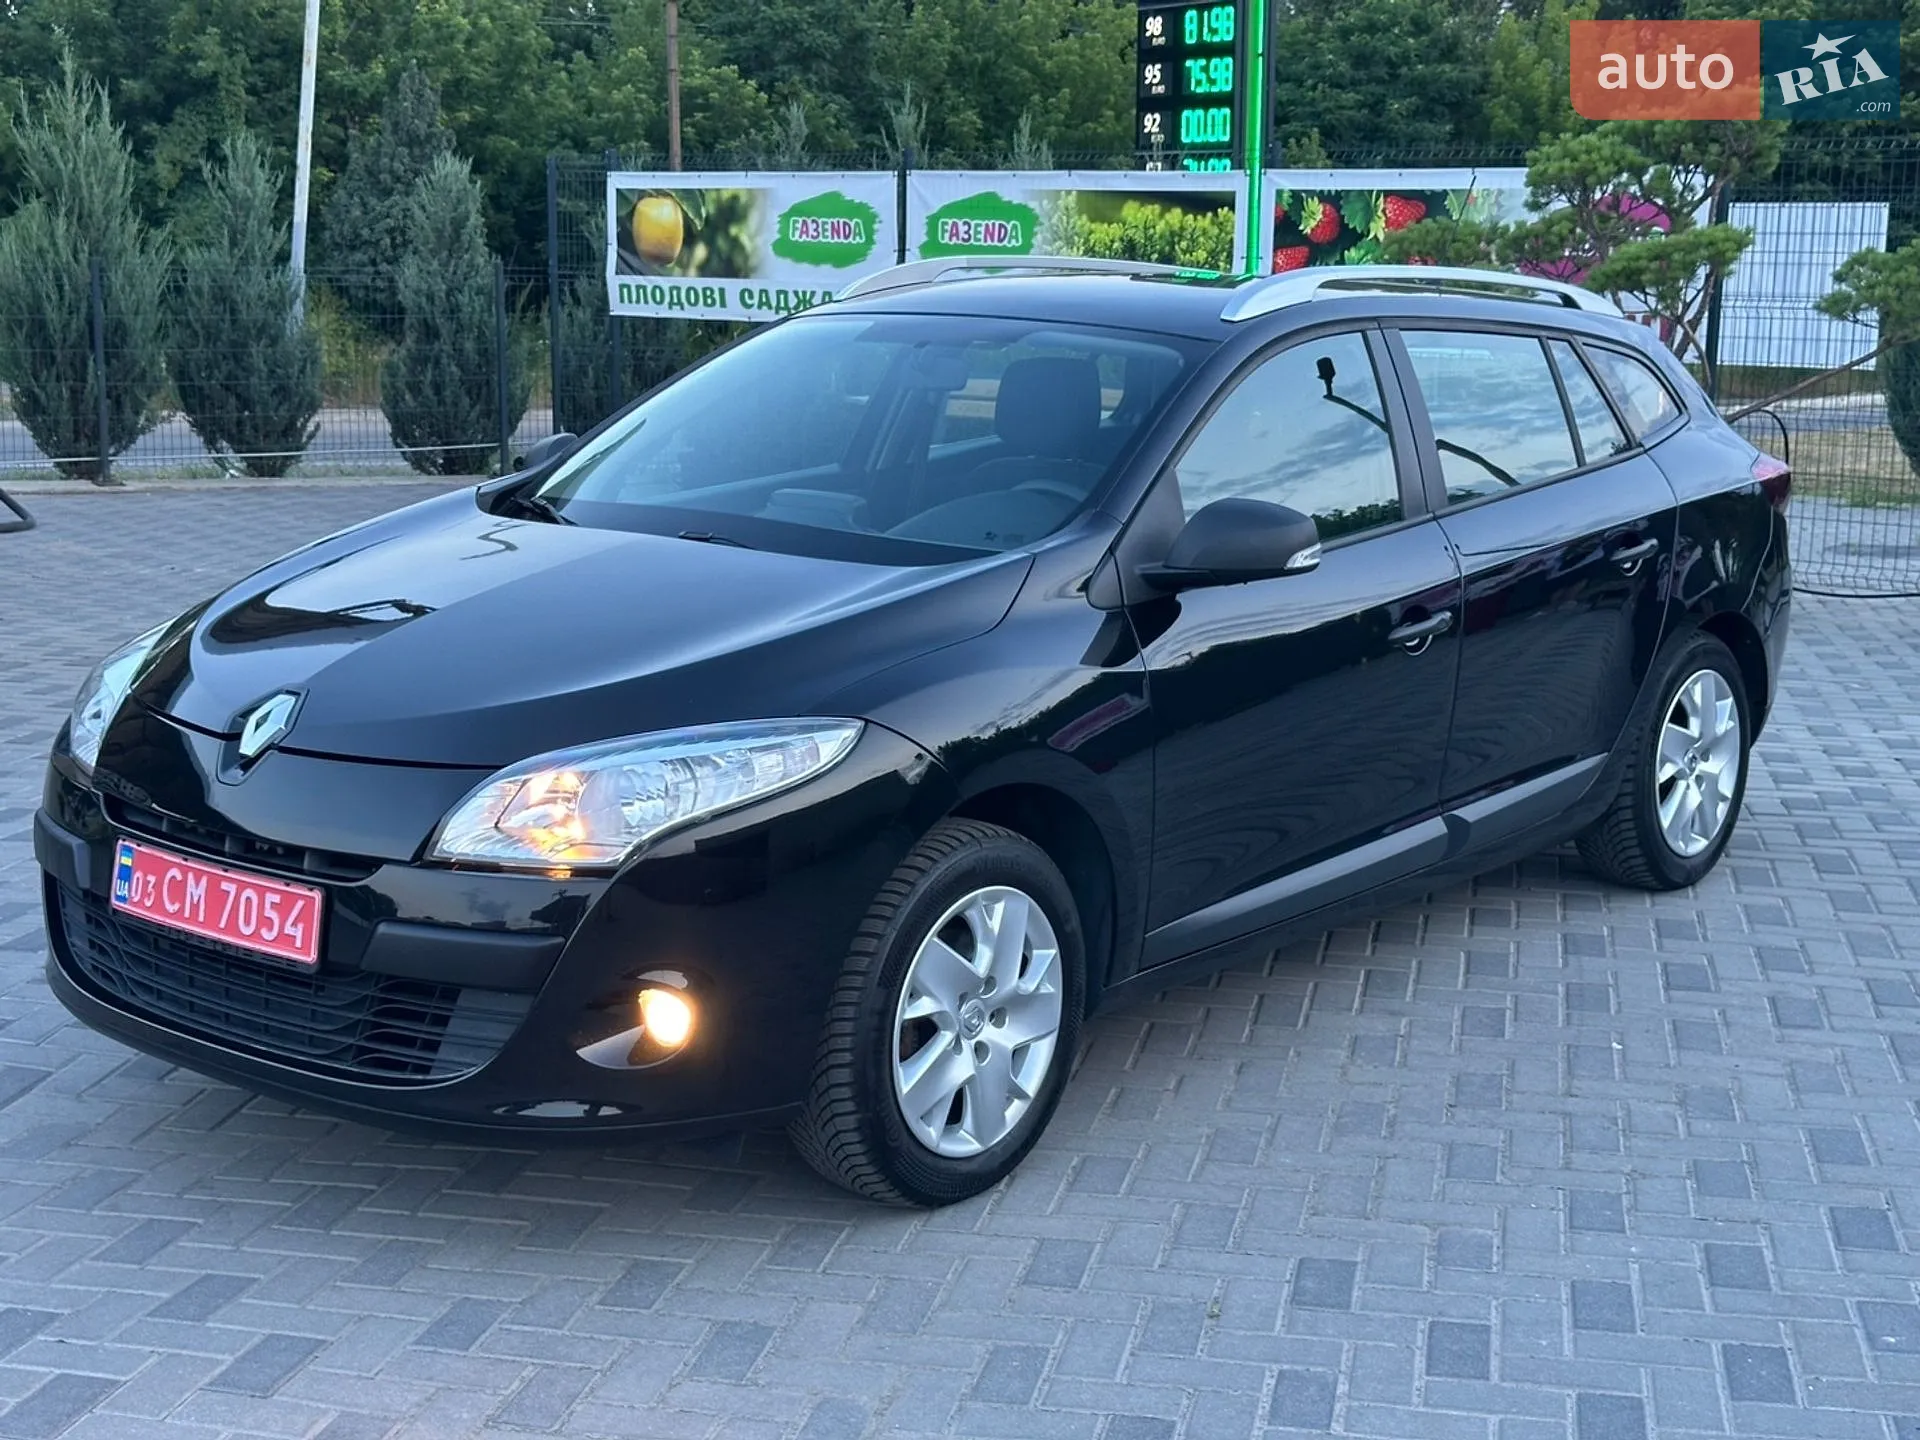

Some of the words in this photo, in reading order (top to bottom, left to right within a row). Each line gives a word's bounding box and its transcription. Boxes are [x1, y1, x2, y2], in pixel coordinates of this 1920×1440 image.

[1145, 15, 1163, 37] 98
[1144, 63, 1162, 85] 95
[1143, 112, 1161, 134] 92
[618, 283, 728, 311] ПЛОДОВІ
[116, 879, 129, 898] UA
[130, 870, 157, 908] 03
[162, 867, 208, 922] CM
[218, 881, 306, 949] 7054
